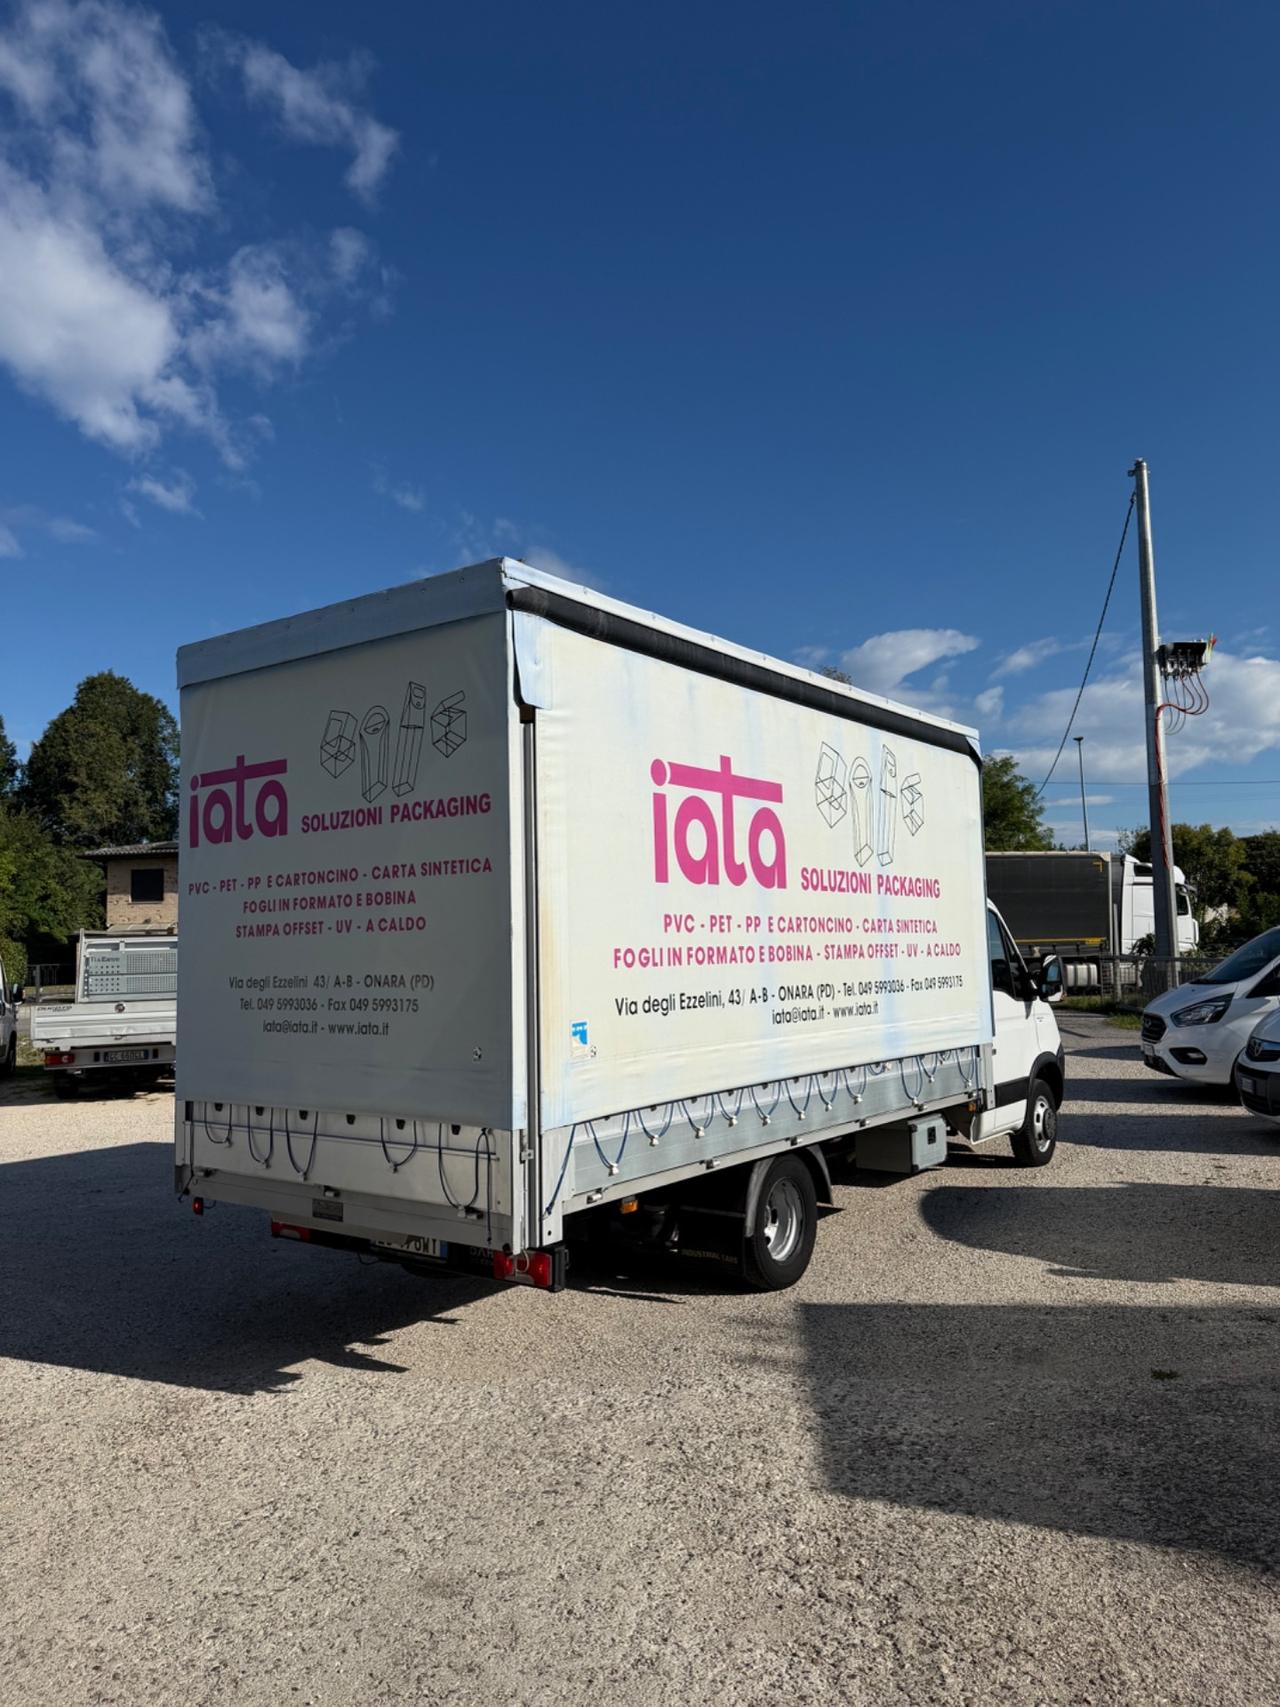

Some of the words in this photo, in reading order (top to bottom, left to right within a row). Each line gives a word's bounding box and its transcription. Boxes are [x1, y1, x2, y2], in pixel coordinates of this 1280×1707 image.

[190, 755, 288, 848] iata
[301, 807, 382, 833] SOLUZIONI
[391, 792, 491, 823] PACKAGING
[651, 755, 787, 889] iata
[189, 882, 209, 895] PVC
[220, 879, 237, 892] PET
[248, 877, 261, 889] PP
[267, 875, 272, 888] E
[276, 868, 358, 887] CARTONCINO
[372, 864, 416, 879] CARTA
[421, 858, 492, 876] SINTETICA
[801, 866, 871, 893] SOLUZIONI
[877, 874, 940, 898] PACKAGING
[243, 899, 276, 913] FOGLI
[279, 899, 289, 911] IN
[293, 894, 352, 910] FORMATO
[357, 893, 362, 906] E
[366, 890, 416, 906] BOBINA
[236, 924, 279, 938] STAMPA
[283, 921, 323, 935] OFFSET
[336, 920, 352, 933] UV
[366, 919, 374, 932] A
[378, 917, 426, 932] CALDO
[664, 914, 694, 933] PVC
[710, 915, 732, 933] PET
[746, 916, 761, 932] PP
[768, 916, 773, 933] E
[778, 916, 852, 933] CARTONCINO
[863, 918, 894, 933] CARTA
[896, 919, 937, 933] SINTETICA
[614, 948, 663, 968] FOGLI
[668, 947, 682, 966] IN
[687, 946, 755, 965] FORMATO
[759, 946, 765, 962] E
[768, 945, 813, 962] BOBINA
[825, 944, 864, 960] STAMPA
[867, 944, 898, 958] OFFSET
[907, 944, 918, 957] UV
[927, 944, 932, 957] A
[934, 943, 960, 956] CALDO
[229, 977, 243, 988] Via
[246, 976, 270, 991] degli
[273, 976, 307, 988] Ezzelini
[334, 975, 352, 987] A-B
[364, 975, 405, 988] ONARA
[410, 974, 434, 991] (PD)
[240, 998, 254, 1010] Tel.
[257, 998, 274, 1010] 049
[277, 998, 317, 1011] 5993036
[328, 998, 346, 1011] Fax
[350, 998, 369, 1011] 049
[372, 998, 419, 1012] 5993175
[615, 998, 637, 1015] Via
[643, 994, 675, 1016] degli
[680, 991, 724, 1009] Ezzelini,
[750, 987, 768, 1003] A-B
[779, 985, 813, 1001] ONARA
[817, 984, 835, 1001] (PD)
[843, 983, 855, 996] Tel.
[859, 981, 872, 995] 049
[875, 980, 904, 994] 5993036
[911, 979, 923, 991] Fax
[925, 977, 936, 990] 049
[938, 976, 962, 989] 5993175
[773, 1006, 824, 1024] iata@iata.it
[833, 1002, 878, 1017] www.iata.it
[263, 1020, 318, 1033] iata@iata.it
[328, 1022, 389, 1035] www.iata.it
